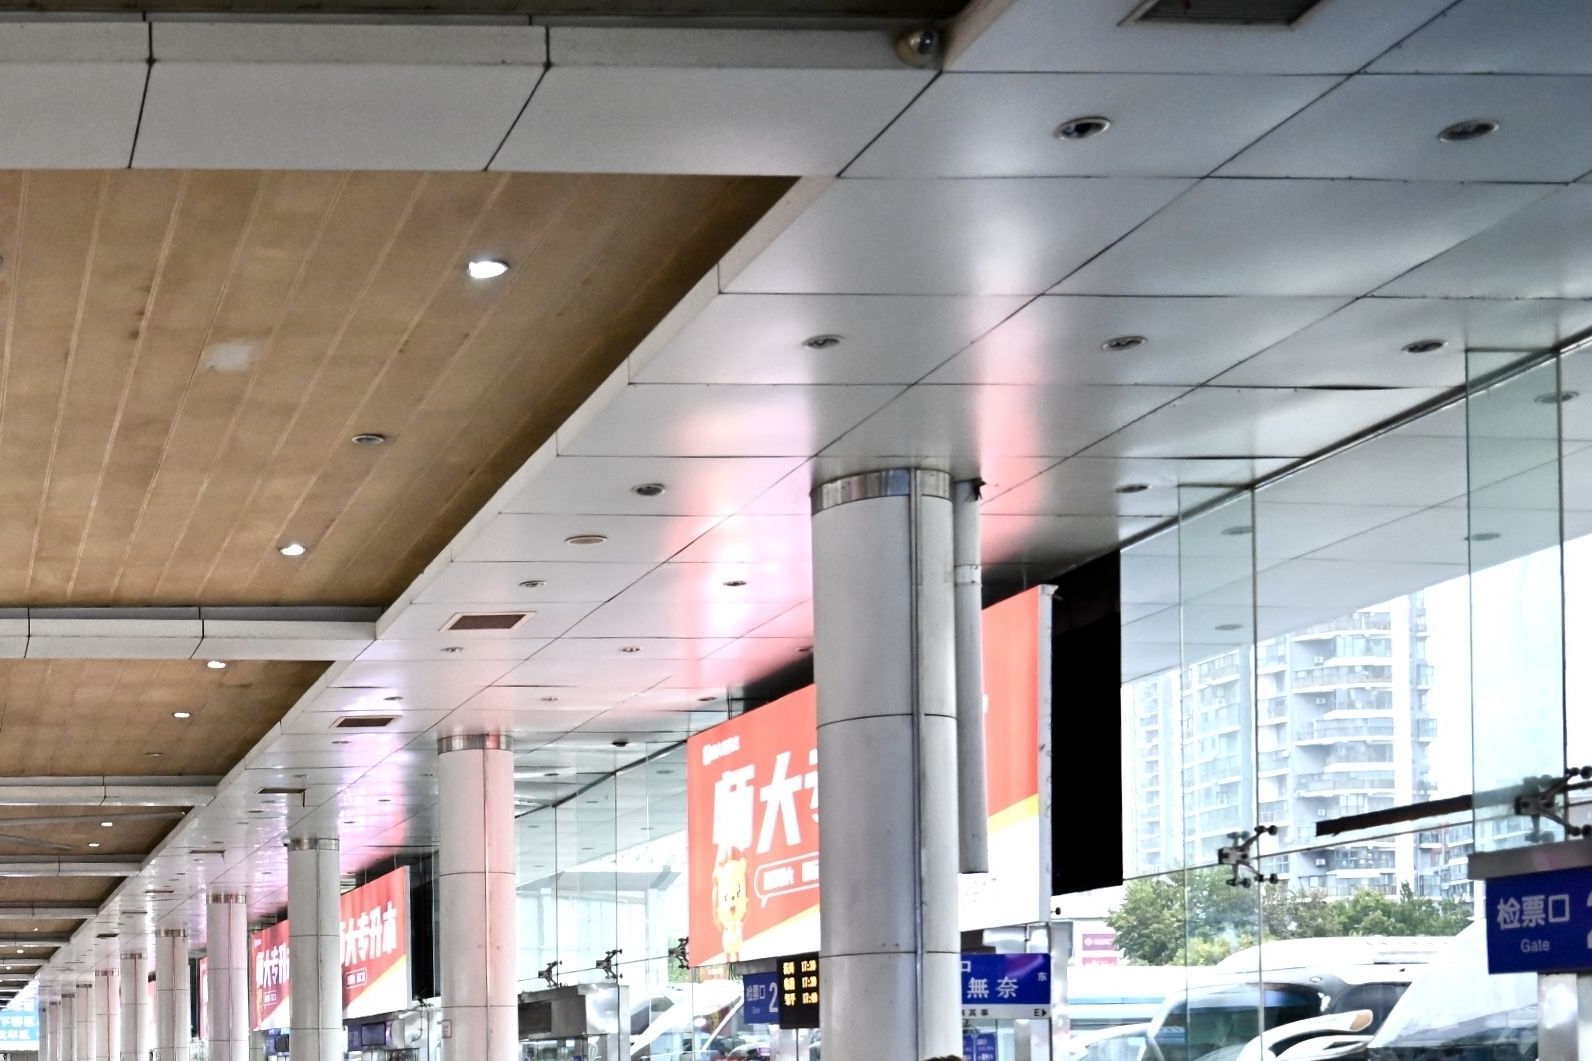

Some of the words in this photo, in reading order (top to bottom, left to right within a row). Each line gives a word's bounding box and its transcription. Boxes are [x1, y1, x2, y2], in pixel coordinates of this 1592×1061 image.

[1497, 894, 1571, 930] 检票口
[1520, 938, 1551, 953] Gate
